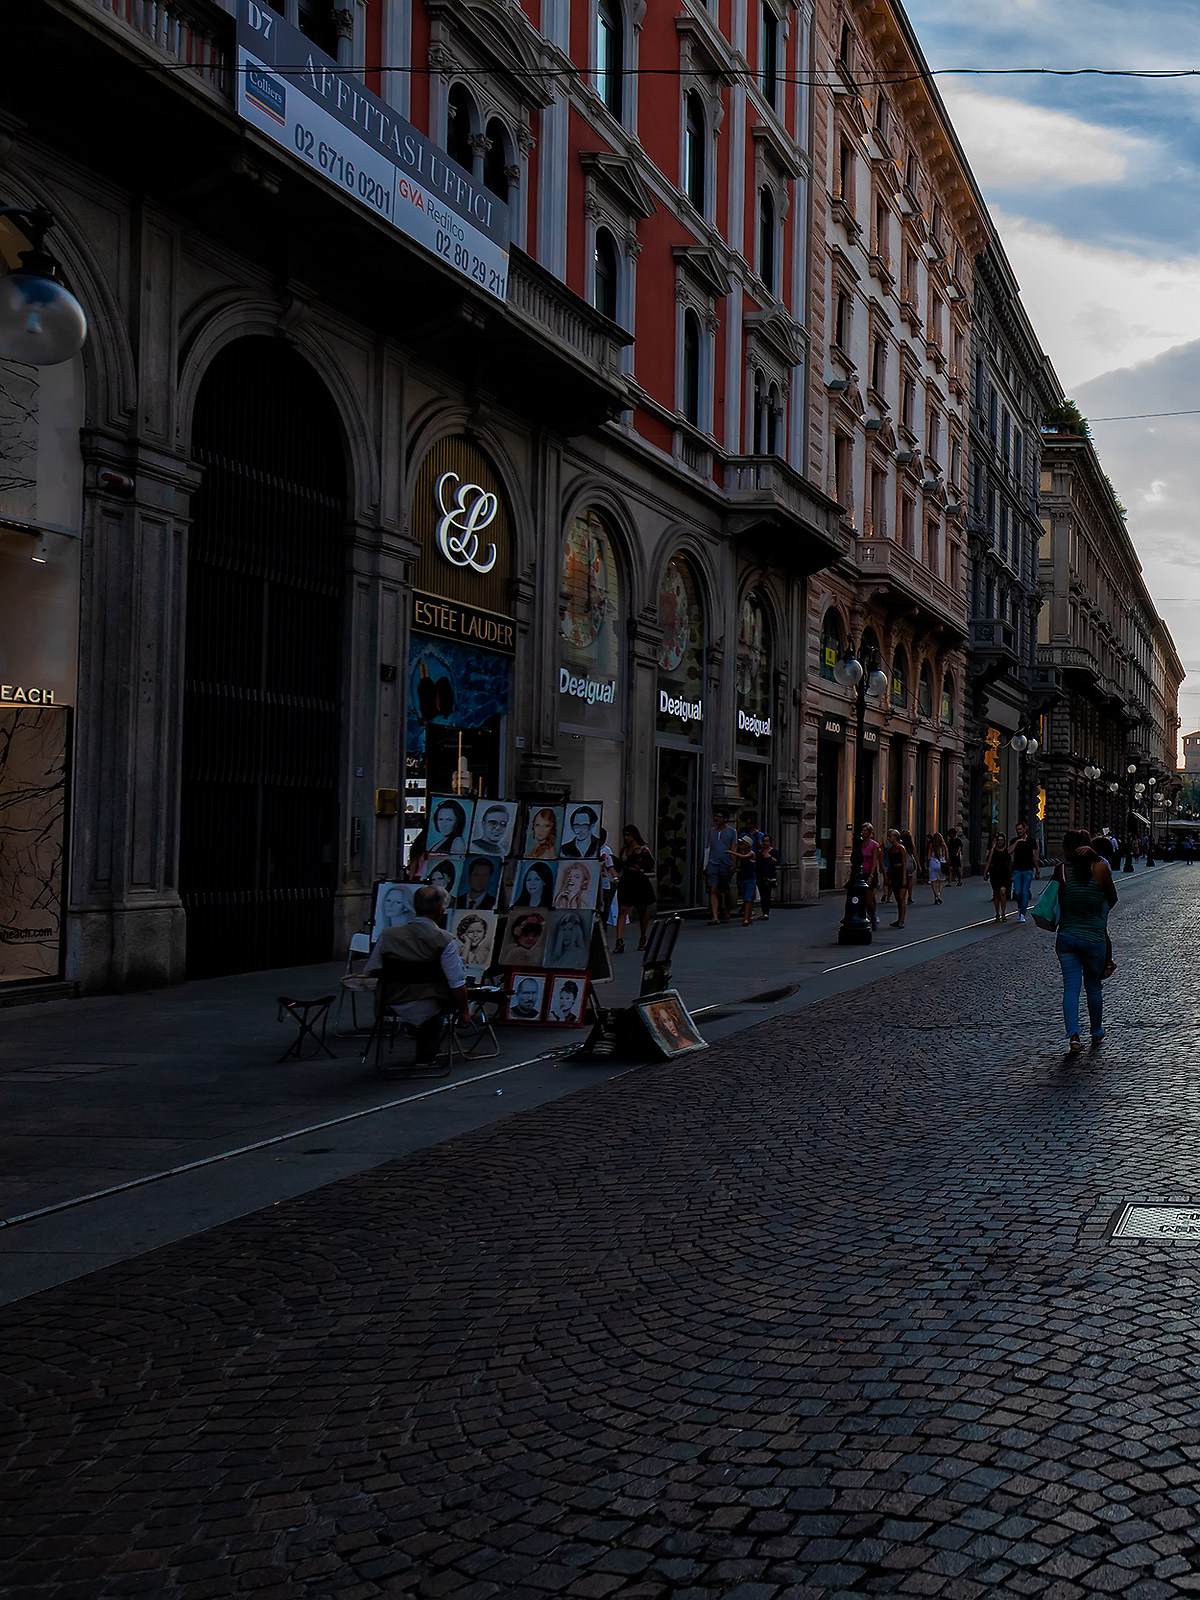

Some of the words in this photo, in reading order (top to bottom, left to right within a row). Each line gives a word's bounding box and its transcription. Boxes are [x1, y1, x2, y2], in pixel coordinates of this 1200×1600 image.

[248, 1, 274, 40] D7
[250, 69, 282, 104] Colliers
[300, 54, 424, 175] AFFITTASI
[430, 154, 493, 229] UFFICI
[295, 123, 314, 160] 02
[318, 141, 355, 188] 6716
[358, 171, 390, 215] 0201
[399, 179, 425, 212] GVA
[427, 199, 465, 241] Redilco
[436, 229, 451, 259] 02
[454, 243, 469, 272] 80
[472, 256, 486, 284] 29
[489, 269, 505, 299] 211
[460, 612, 513, 647] LAUDER
[559, 667, 616, 706] Desigual
[660, 690, 704, 723] Desigual
[738, 709, 771, 738] Desigual
[825, 720, 841, 734] ALDO
[863, 730, 877, 743] ALDO
